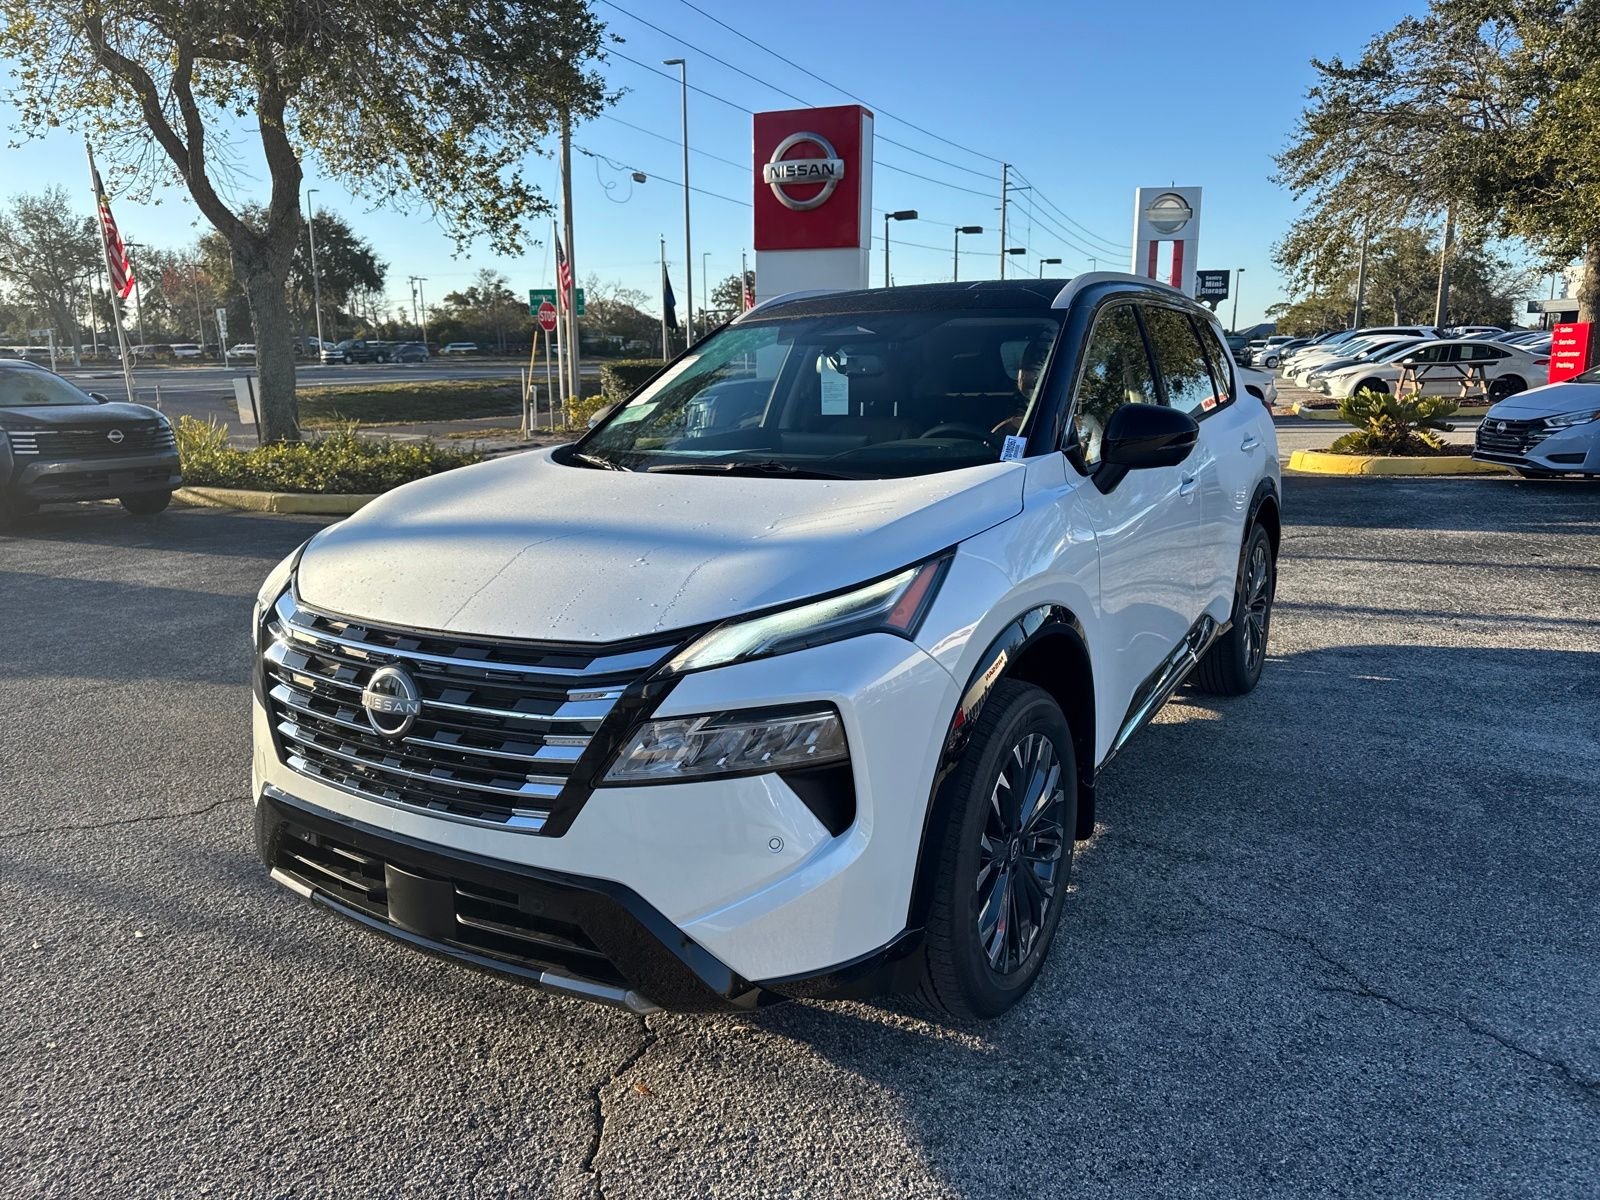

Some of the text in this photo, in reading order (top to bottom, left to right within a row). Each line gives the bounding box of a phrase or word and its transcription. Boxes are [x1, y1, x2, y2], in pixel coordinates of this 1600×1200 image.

[770, 163, 834, 178] NISSAN
[1201, 287, 1227, 295] Storage
[540, 310, 556, 322] STOP
[1558, 338, 1577, 346] Service
[1555, 362, 1575, 370] Parking
[363, 693, 418, 714] NISSAN
